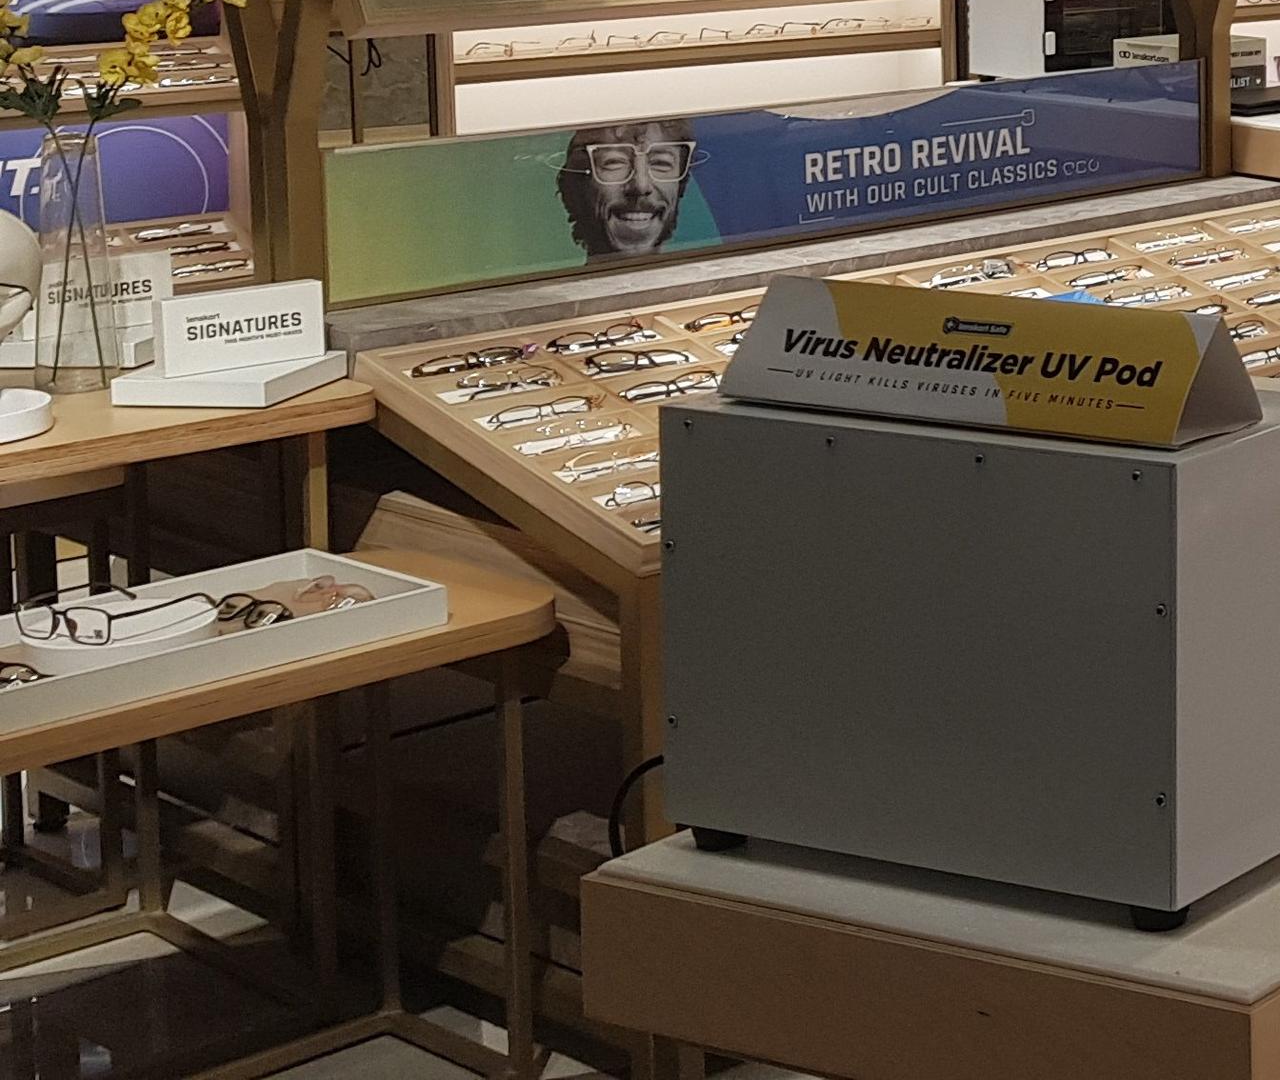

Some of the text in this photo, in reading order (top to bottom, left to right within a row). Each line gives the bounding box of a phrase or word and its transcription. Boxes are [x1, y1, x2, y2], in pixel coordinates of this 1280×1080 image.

[804, 126, 1031, 184] RETRO REVIVAL
[806, 159, 1058, 214] WITH OUR CULT CLASSICS
[187, 312, 301, 341] SIGNATURES
[783, 328, 1163, 387] Virus Neutralizer UV Pod
[793, 368, 1115, 410] UV LIGHT KILLS VIRUSES IN FIVE MINUTES
